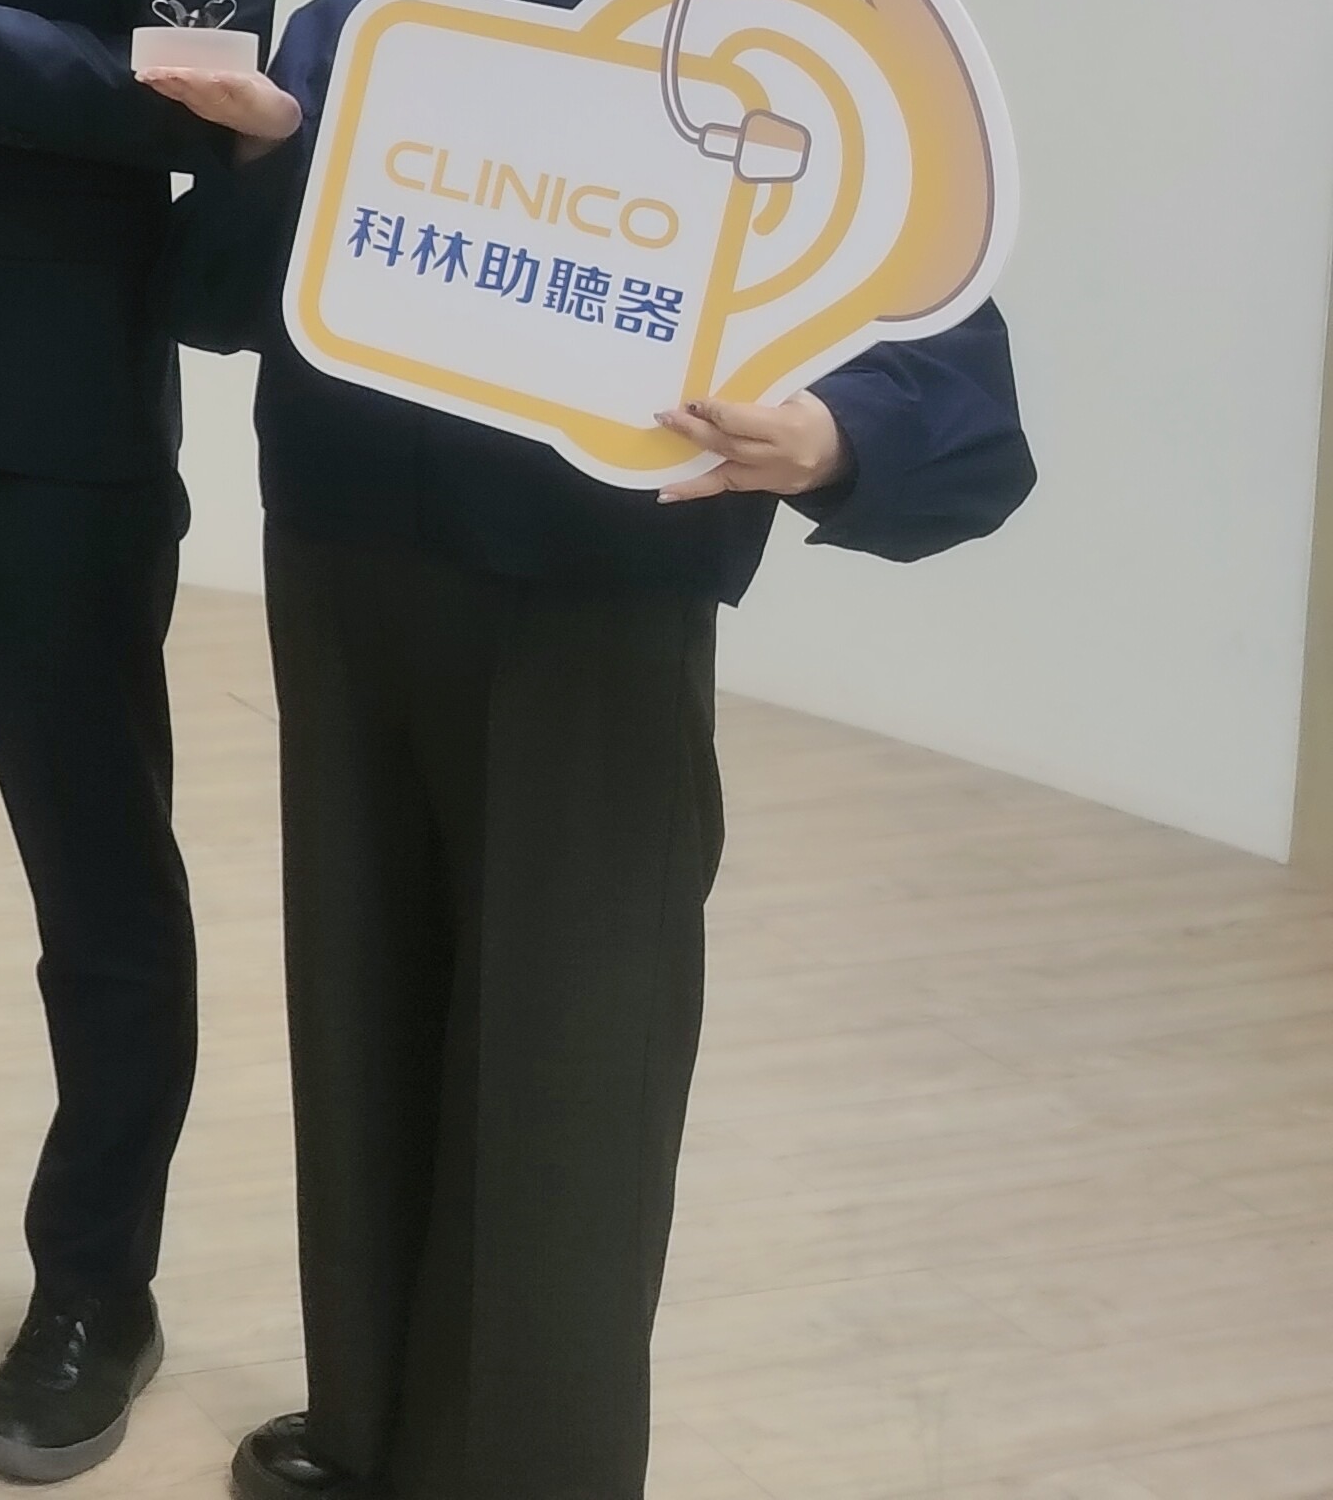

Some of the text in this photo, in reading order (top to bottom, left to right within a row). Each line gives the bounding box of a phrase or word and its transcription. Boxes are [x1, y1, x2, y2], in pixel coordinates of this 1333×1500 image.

[385, 141, 680, 249] CLINICO
[347, 206, 684, 342] 科林助聽器
